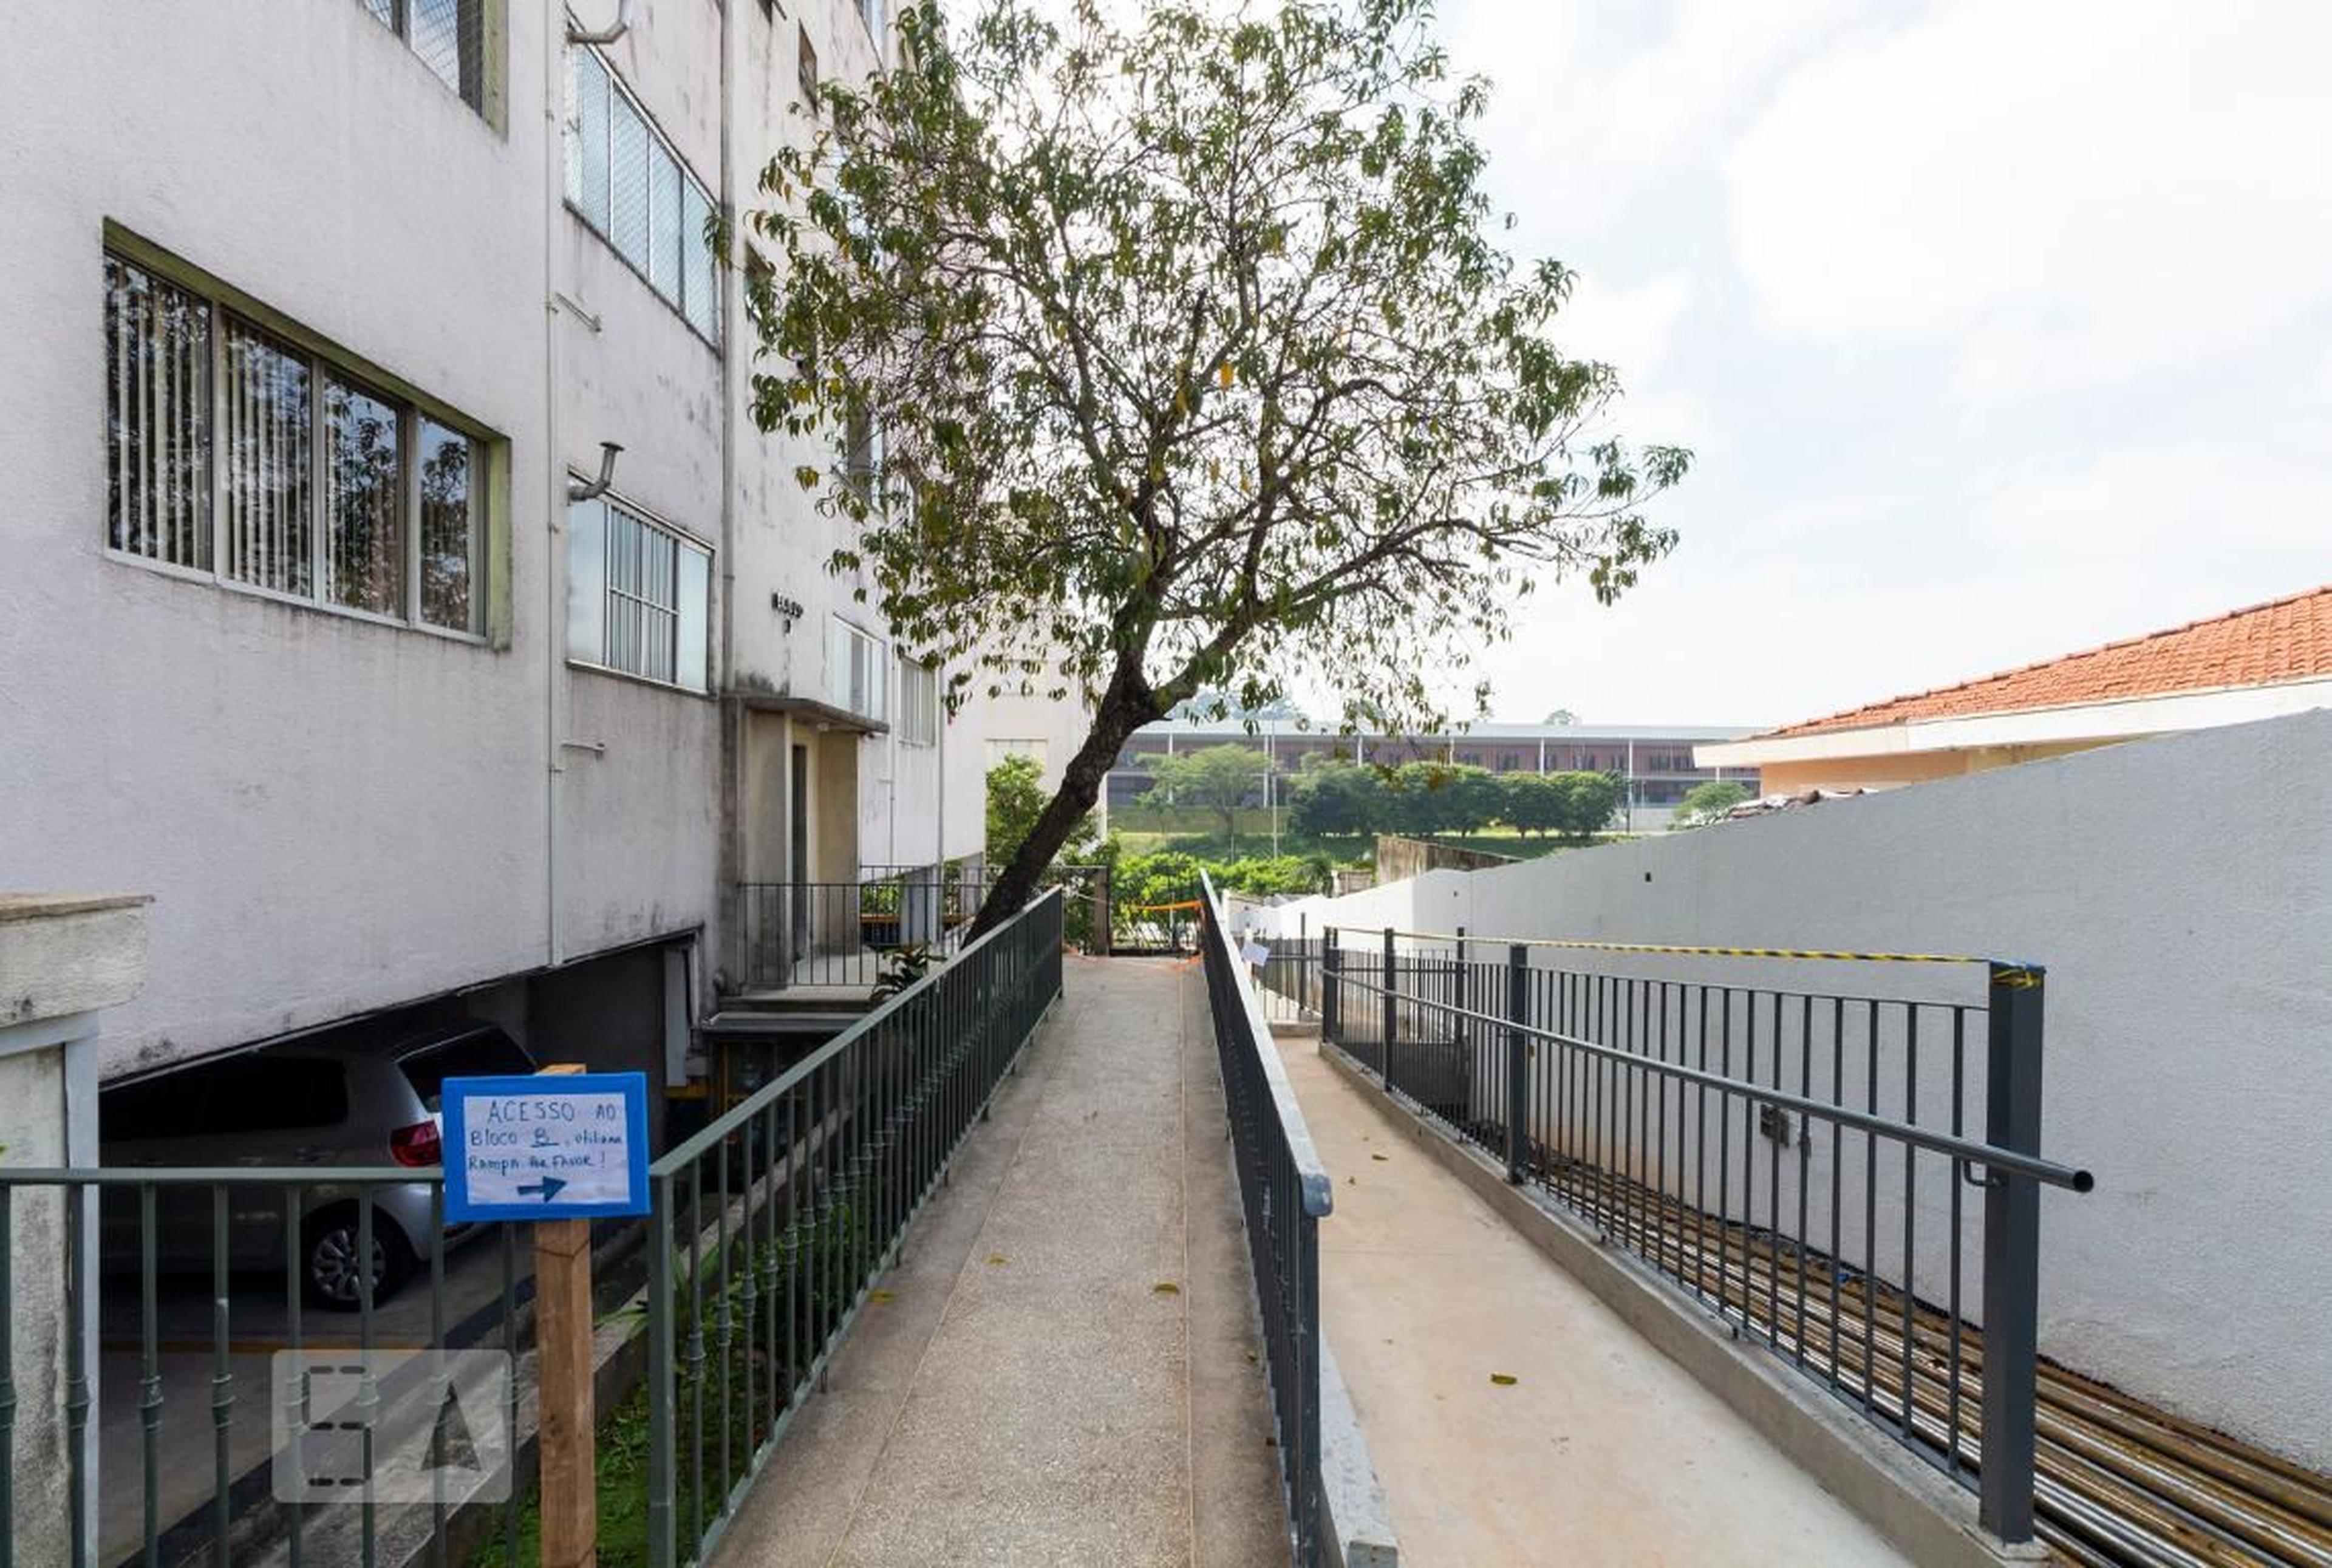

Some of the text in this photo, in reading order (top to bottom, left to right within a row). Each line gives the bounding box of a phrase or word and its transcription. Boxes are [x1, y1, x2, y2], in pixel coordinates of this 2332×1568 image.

[488, 1100, 616, 1123] ACESSO AO
[471, 1130, 517, 1147] Bloco
